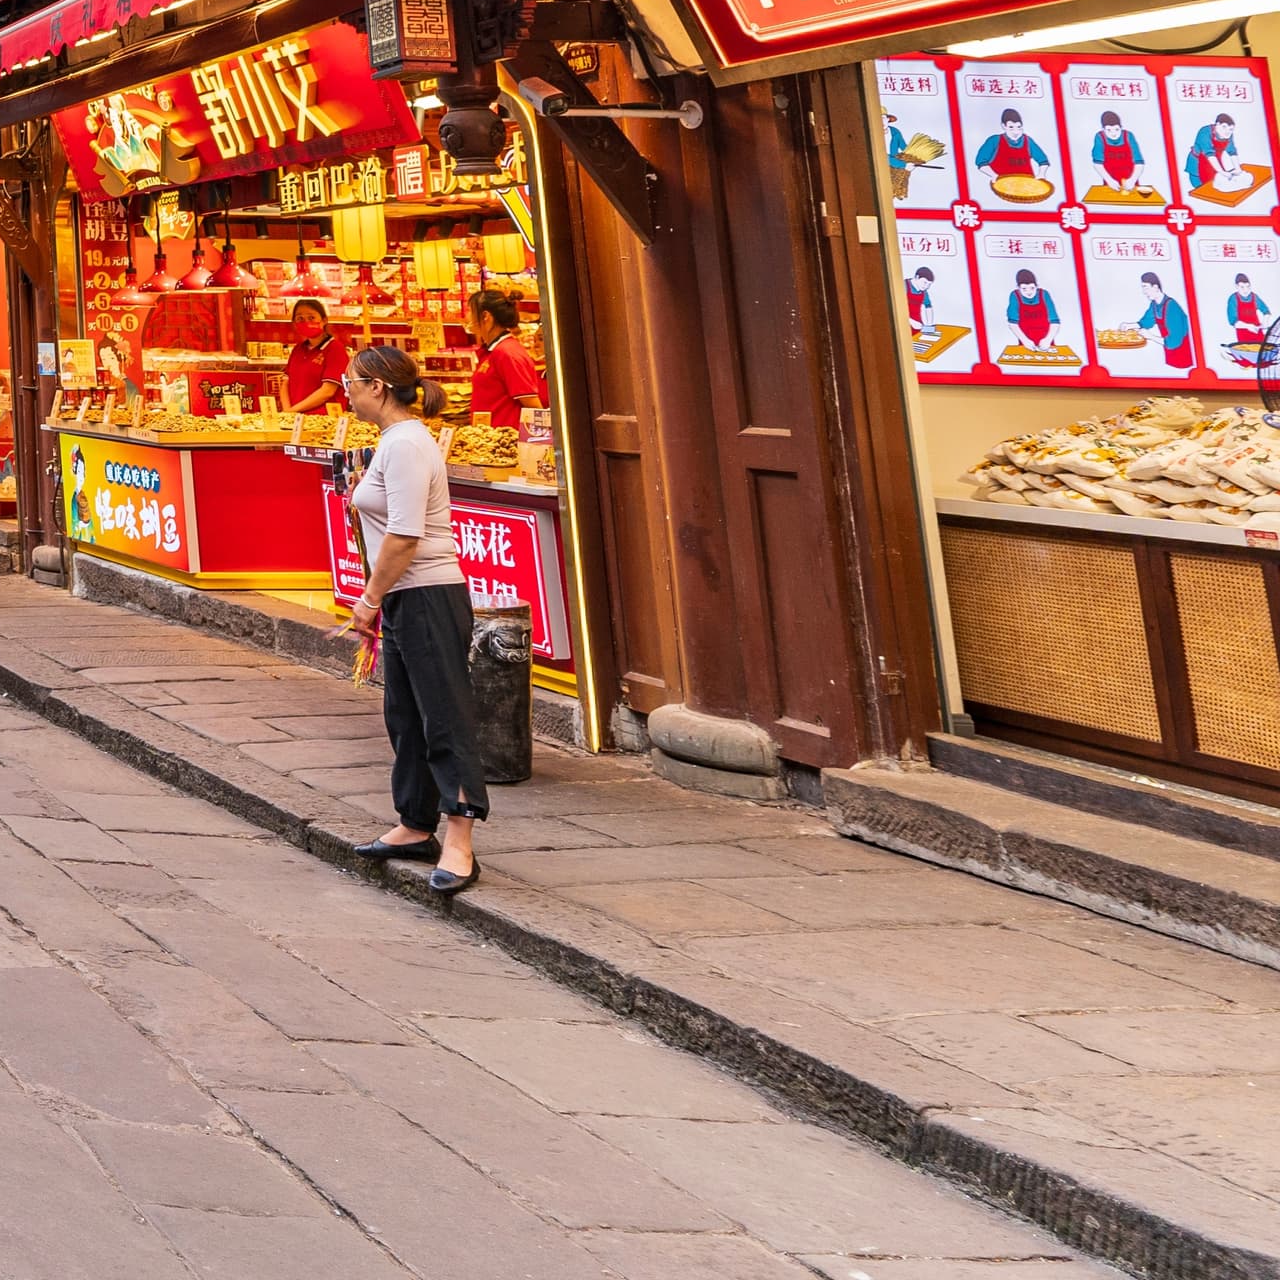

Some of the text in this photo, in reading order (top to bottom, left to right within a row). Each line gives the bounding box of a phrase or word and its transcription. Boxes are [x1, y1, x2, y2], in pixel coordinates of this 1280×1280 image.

[971, 77, 1040, 95] 筛选去杂
[1077, 79, 1144, 98] 黄金配料
[1181, 83, 1250, 101] 揉搓均匀
[953, 204, 1193, 232] 陈 建 平
[105, 460, 161, 493] 重庆必吃特产
[95, 487, 181, 553] 怪味胡豆
